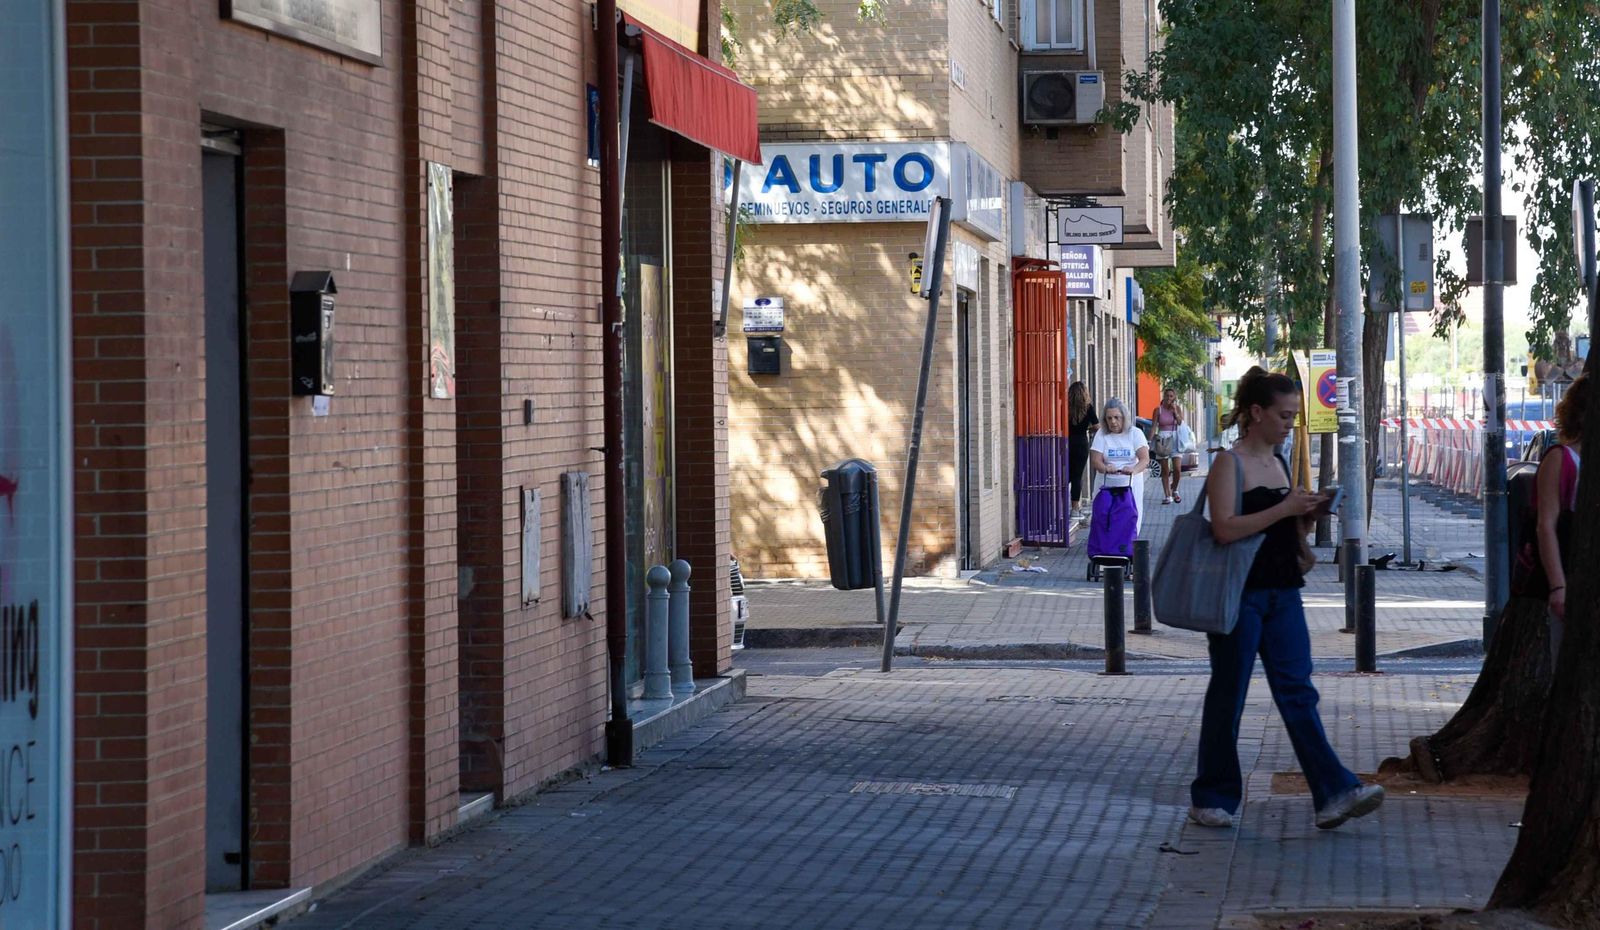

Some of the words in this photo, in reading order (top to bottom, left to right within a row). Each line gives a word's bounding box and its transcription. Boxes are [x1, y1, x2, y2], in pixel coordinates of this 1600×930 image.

[761, 152, 935, 194] AUTO
[741, 200, 810, 216] SEMINUEVOS
[821, 199, 872, 215] SEGUROS
[1062, 251, 1087, 260] SEÑORA
